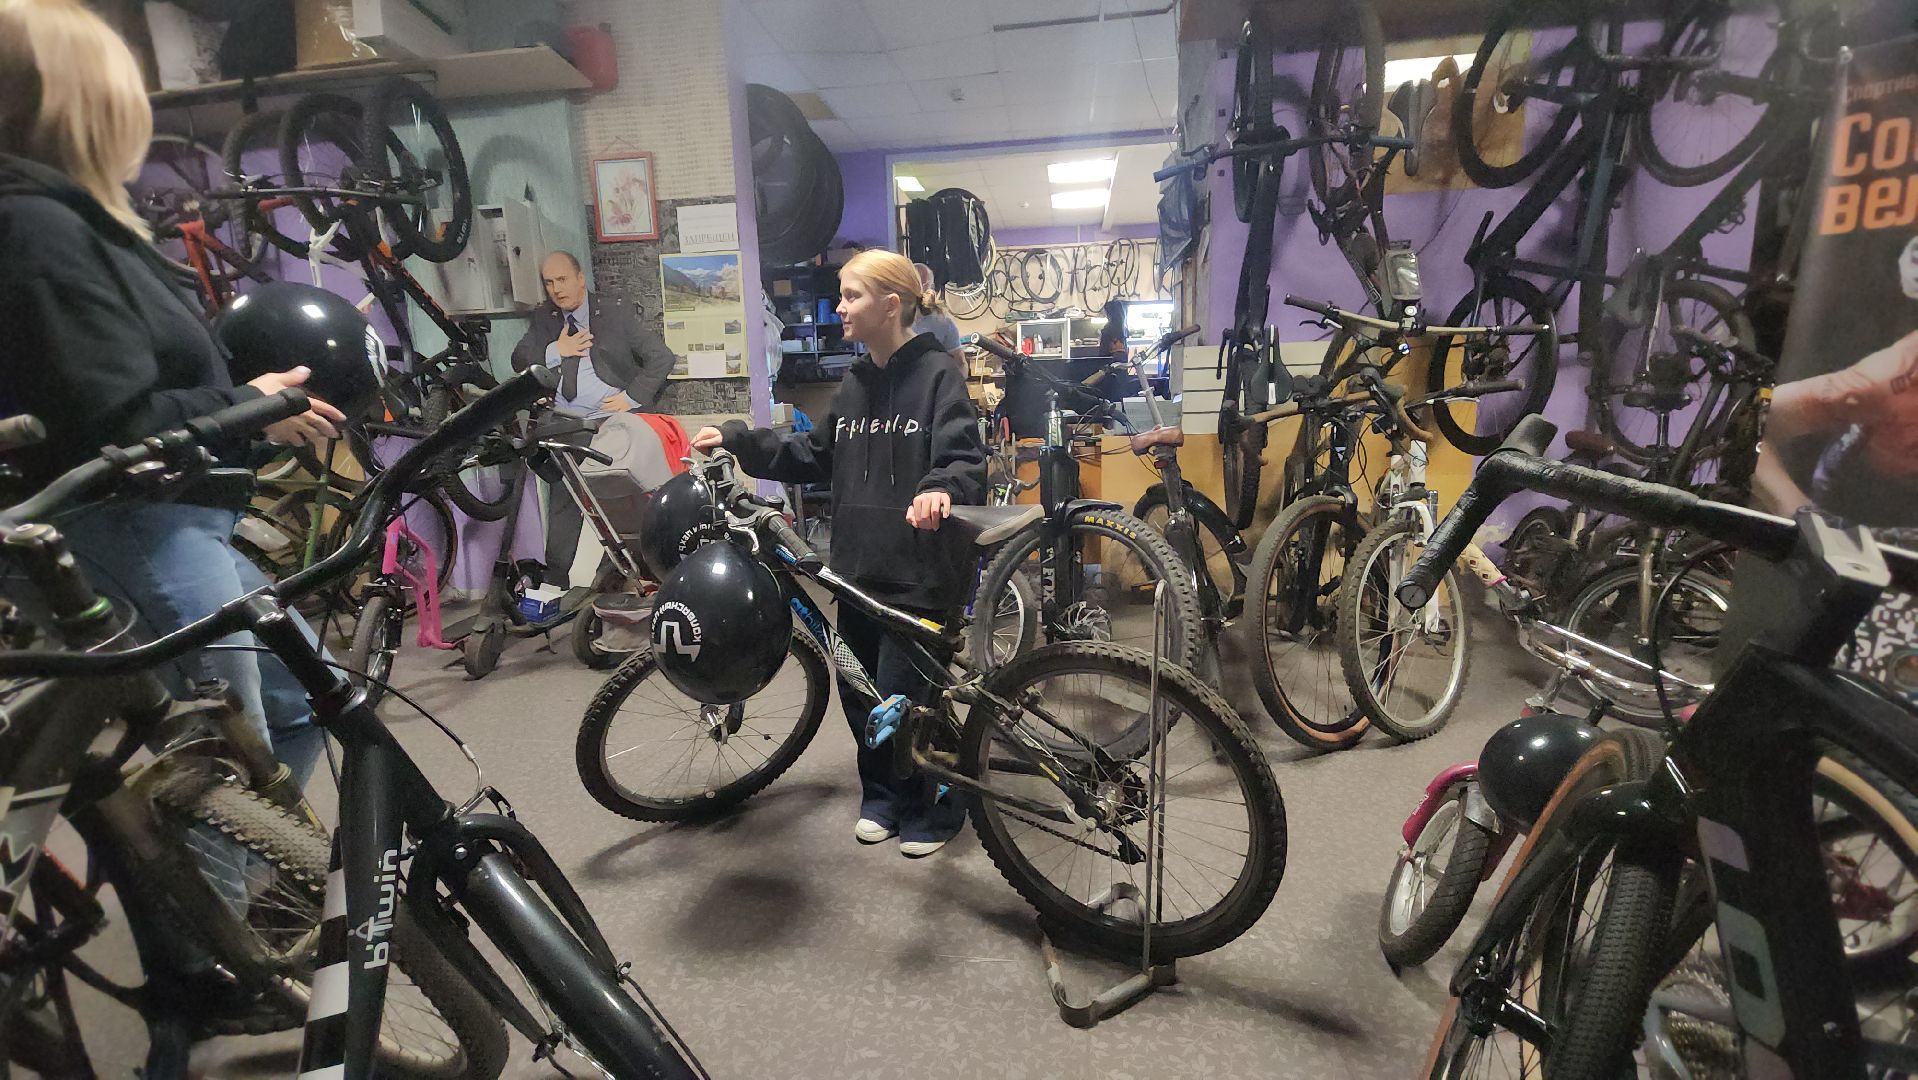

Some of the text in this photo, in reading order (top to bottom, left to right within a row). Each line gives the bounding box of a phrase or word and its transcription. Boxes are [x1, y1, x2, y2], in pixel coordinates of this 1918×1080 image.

[1832, 112, 1918, 177] Со
[1083, 515, 1138, 541] MAXXIS
[1042, 567, 1056, 604] FOX
